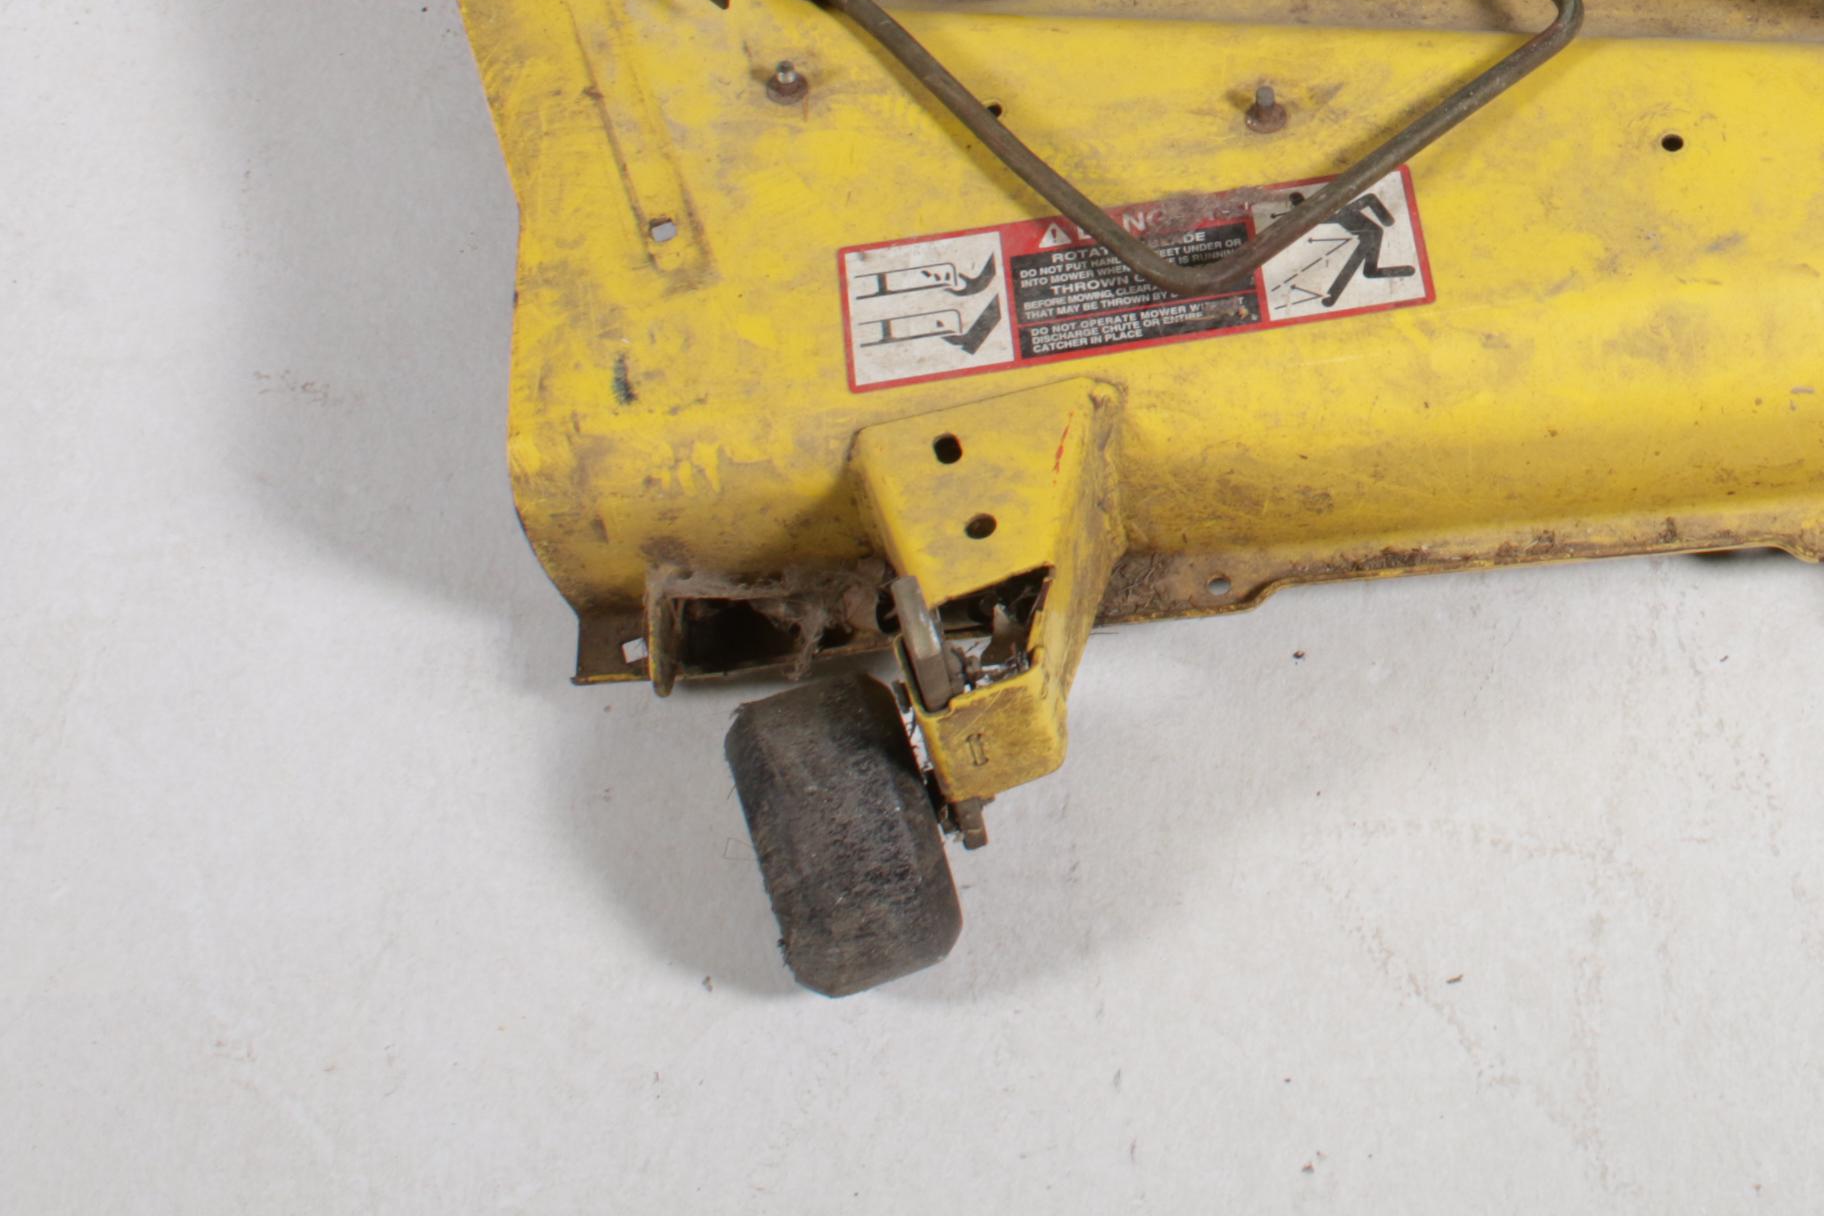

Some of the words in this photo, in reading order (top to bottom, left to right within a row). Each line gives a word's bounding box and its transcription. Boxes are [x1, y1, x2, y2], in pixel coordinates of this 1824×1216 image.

[1020, 269, 1037, 279] DO
[1040, 264, 1063, 276] NOT
[1065, 261, 1088, 271] PUT
[1183, 241, 1222, 254] UNDER
[1225, 238, 1242, 248] OR
[1021, 277, 1048, 288] INTO
[1050, 270, 1095, 284] MOWER
[1050, 275, 1129, 295] THROWN
[1024, 297, 1067, 310] BEFORE
[1116, 284, 1151, 296] CLEAR
[1025, 309, 1054, 320] THAT
[1057, 304, 1080, 315] MAY
[1082, 301, 1098, 311] BE
[1100, 293, 1150, 309] THROWN
[1152, 291, 1168, 300] BY
[1031, 327, 1049, 337] DO
[1052, 322, 1079, 334] NOT
[1080, 312, 1138, 329] OPERATE
[1140, 305, 1187, 319] MOWER
[1032, 327, 1100, 345] DISCHARGE
[1101, 319, 1141, 334] CHUTE
[1143, 317, 1160, 327] OR
[1033, 336, 1088, 353] CATCHER
[1090, 334, 1103, 344] IN
[1104, 328, 1144, 342] PLACE
